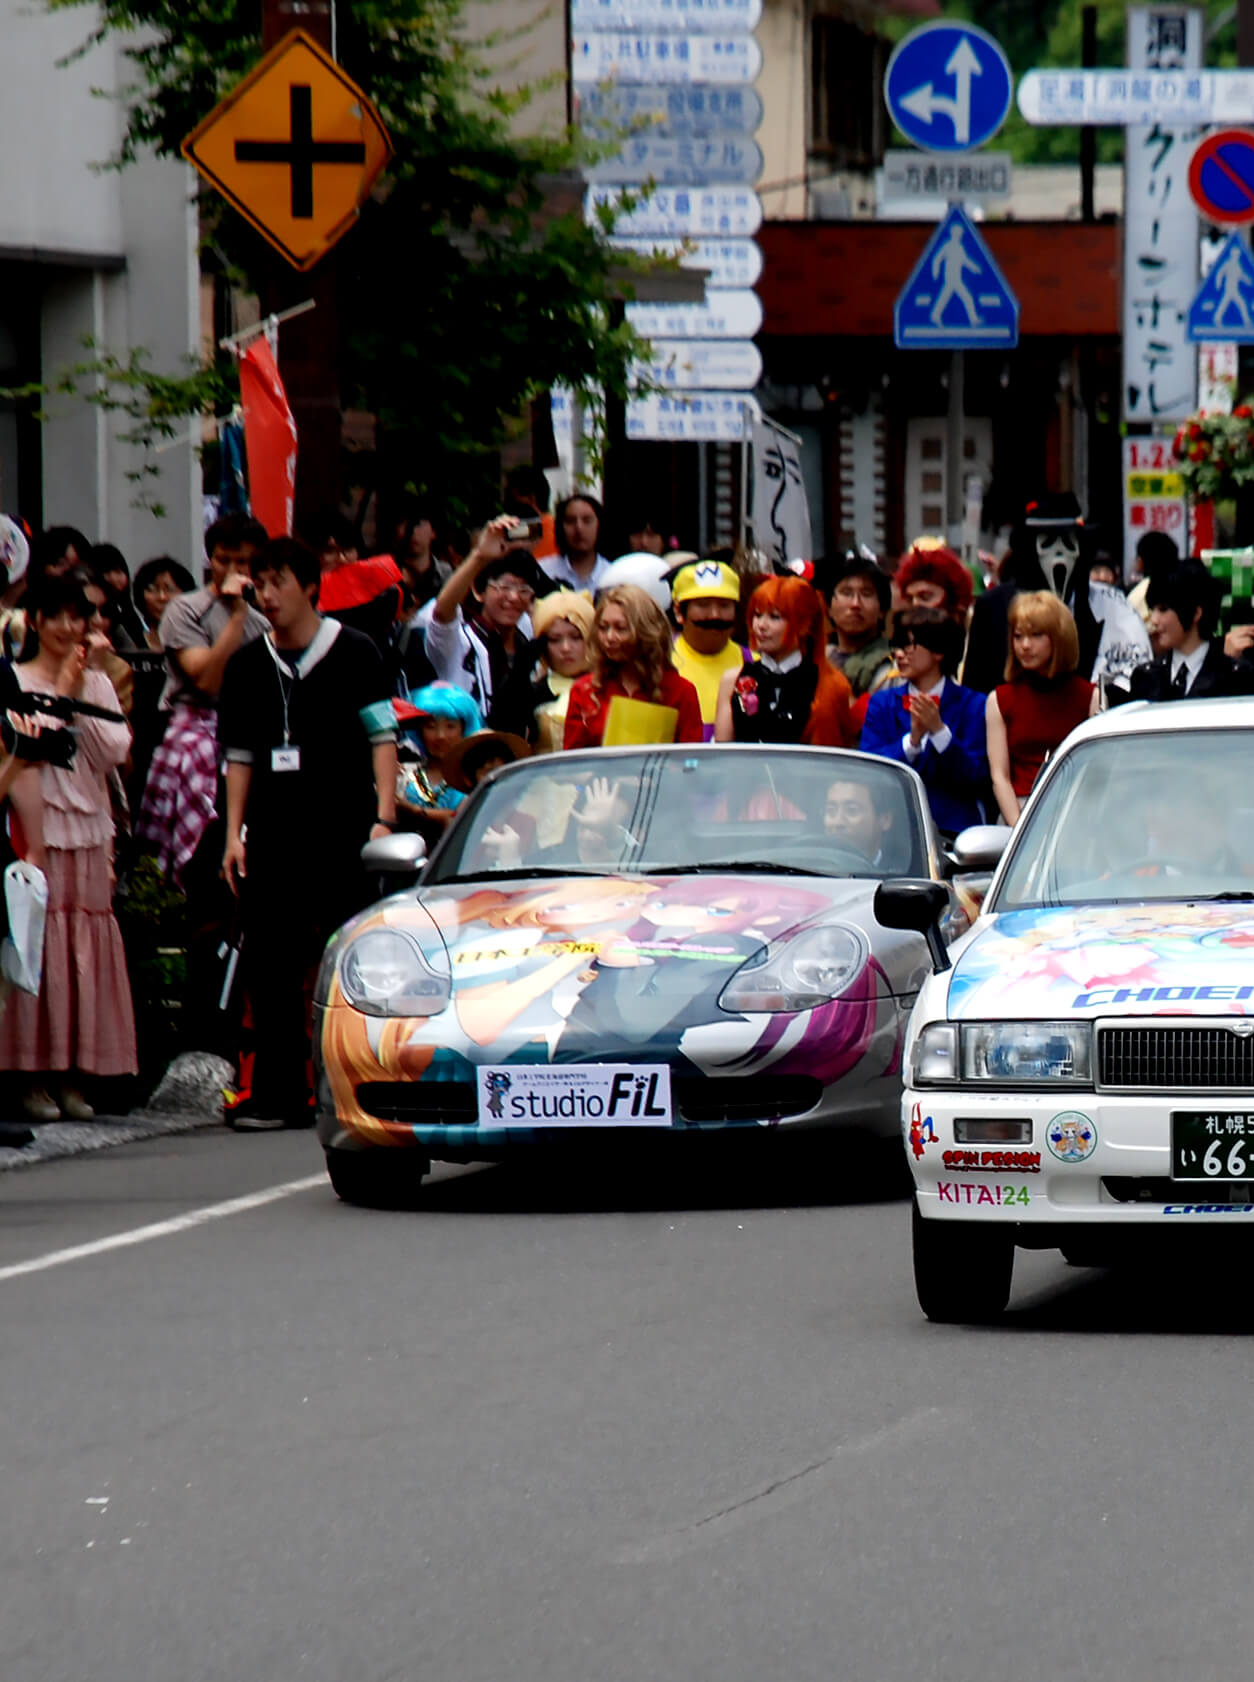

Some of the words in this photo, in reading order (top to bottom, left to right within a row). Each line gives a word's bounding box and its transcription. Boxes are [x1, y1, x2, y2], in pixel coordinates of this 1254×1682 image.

[696, 562, 720, 578] W
[511, 1088, 604, 1118] studio
[1180, 1148, 1197, 1167] い
[937, 1181, 1031, 1206] KITA!24
